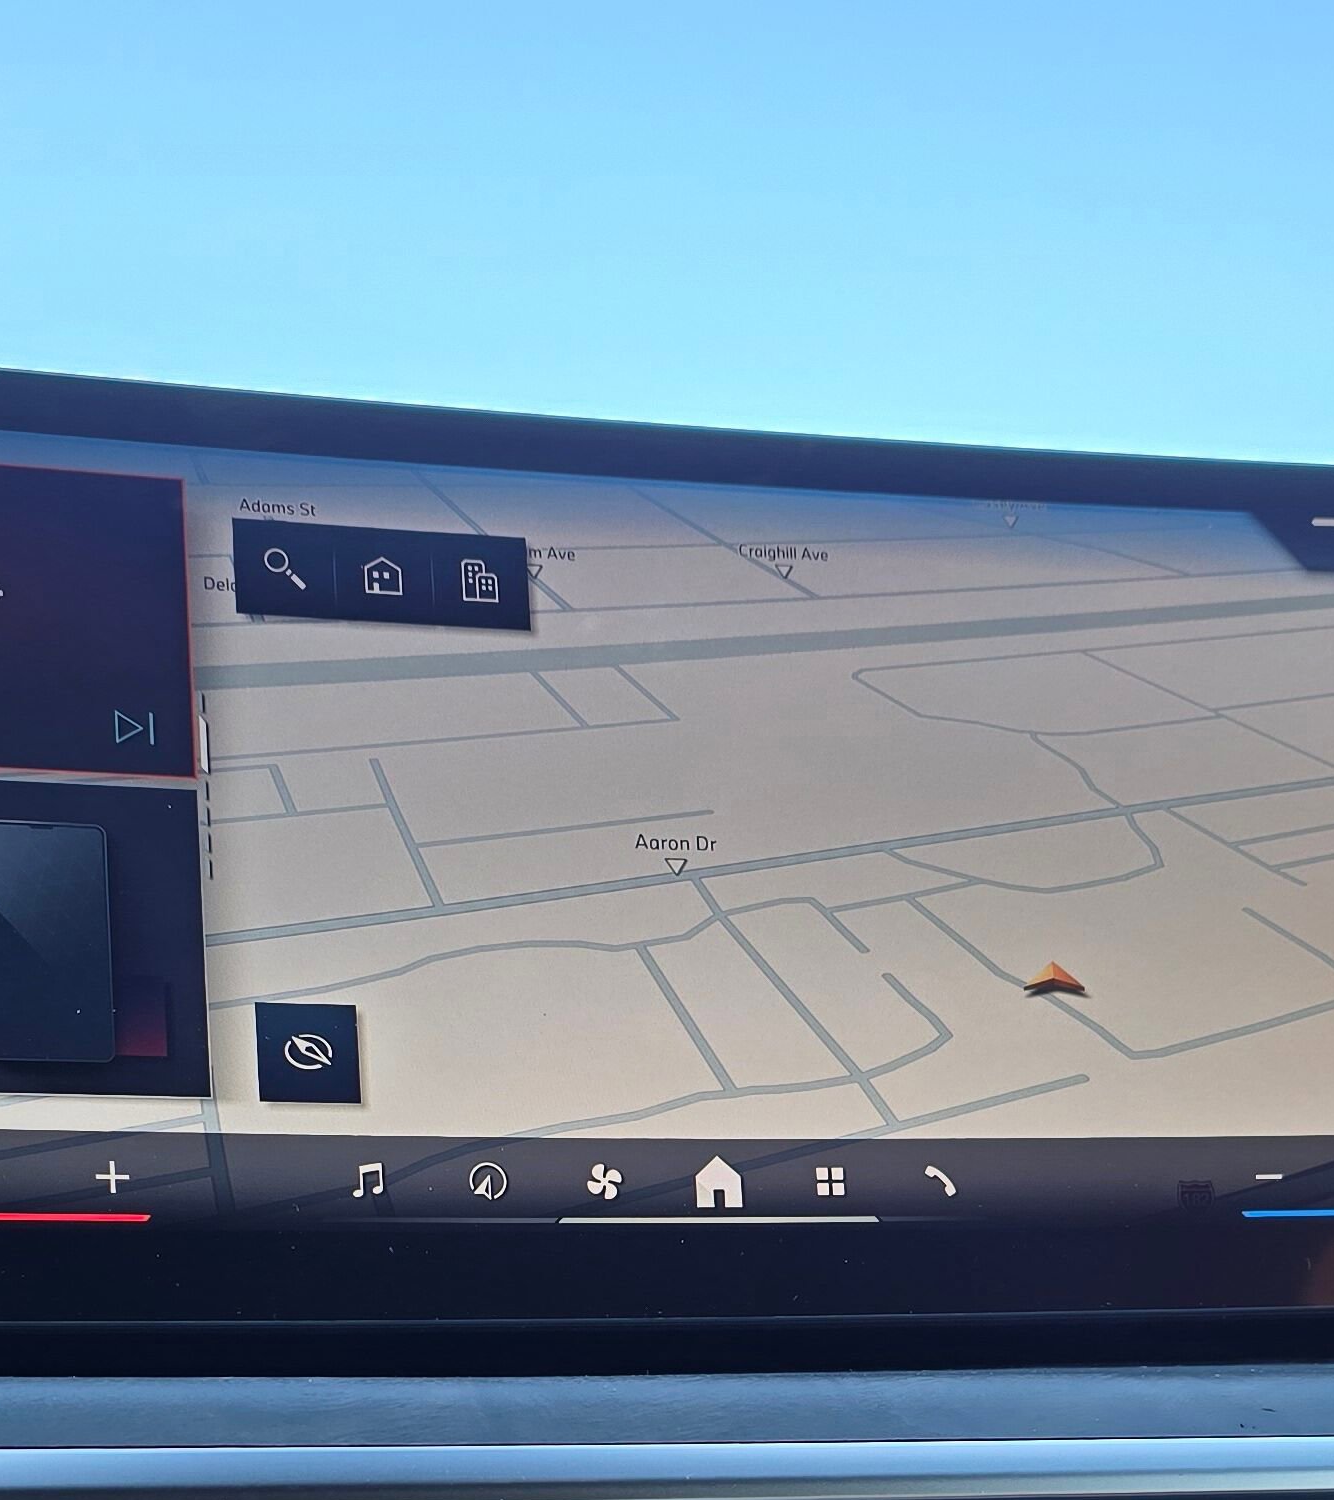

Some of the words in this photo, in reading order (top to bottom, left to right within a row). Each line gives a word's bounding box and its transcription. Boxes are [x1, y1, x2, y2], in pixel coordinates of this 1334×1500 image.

[239, 497, 295, 516] Adams
[299, 502, 317, 517] St
[547, 546, 576, 561] Ave
[739, 543, 797, 561] Craighill
[801, 547, 829, 561] Ave
[635, 833, 690, 851] Aaron
[696, 835, 717, 851] Dr
